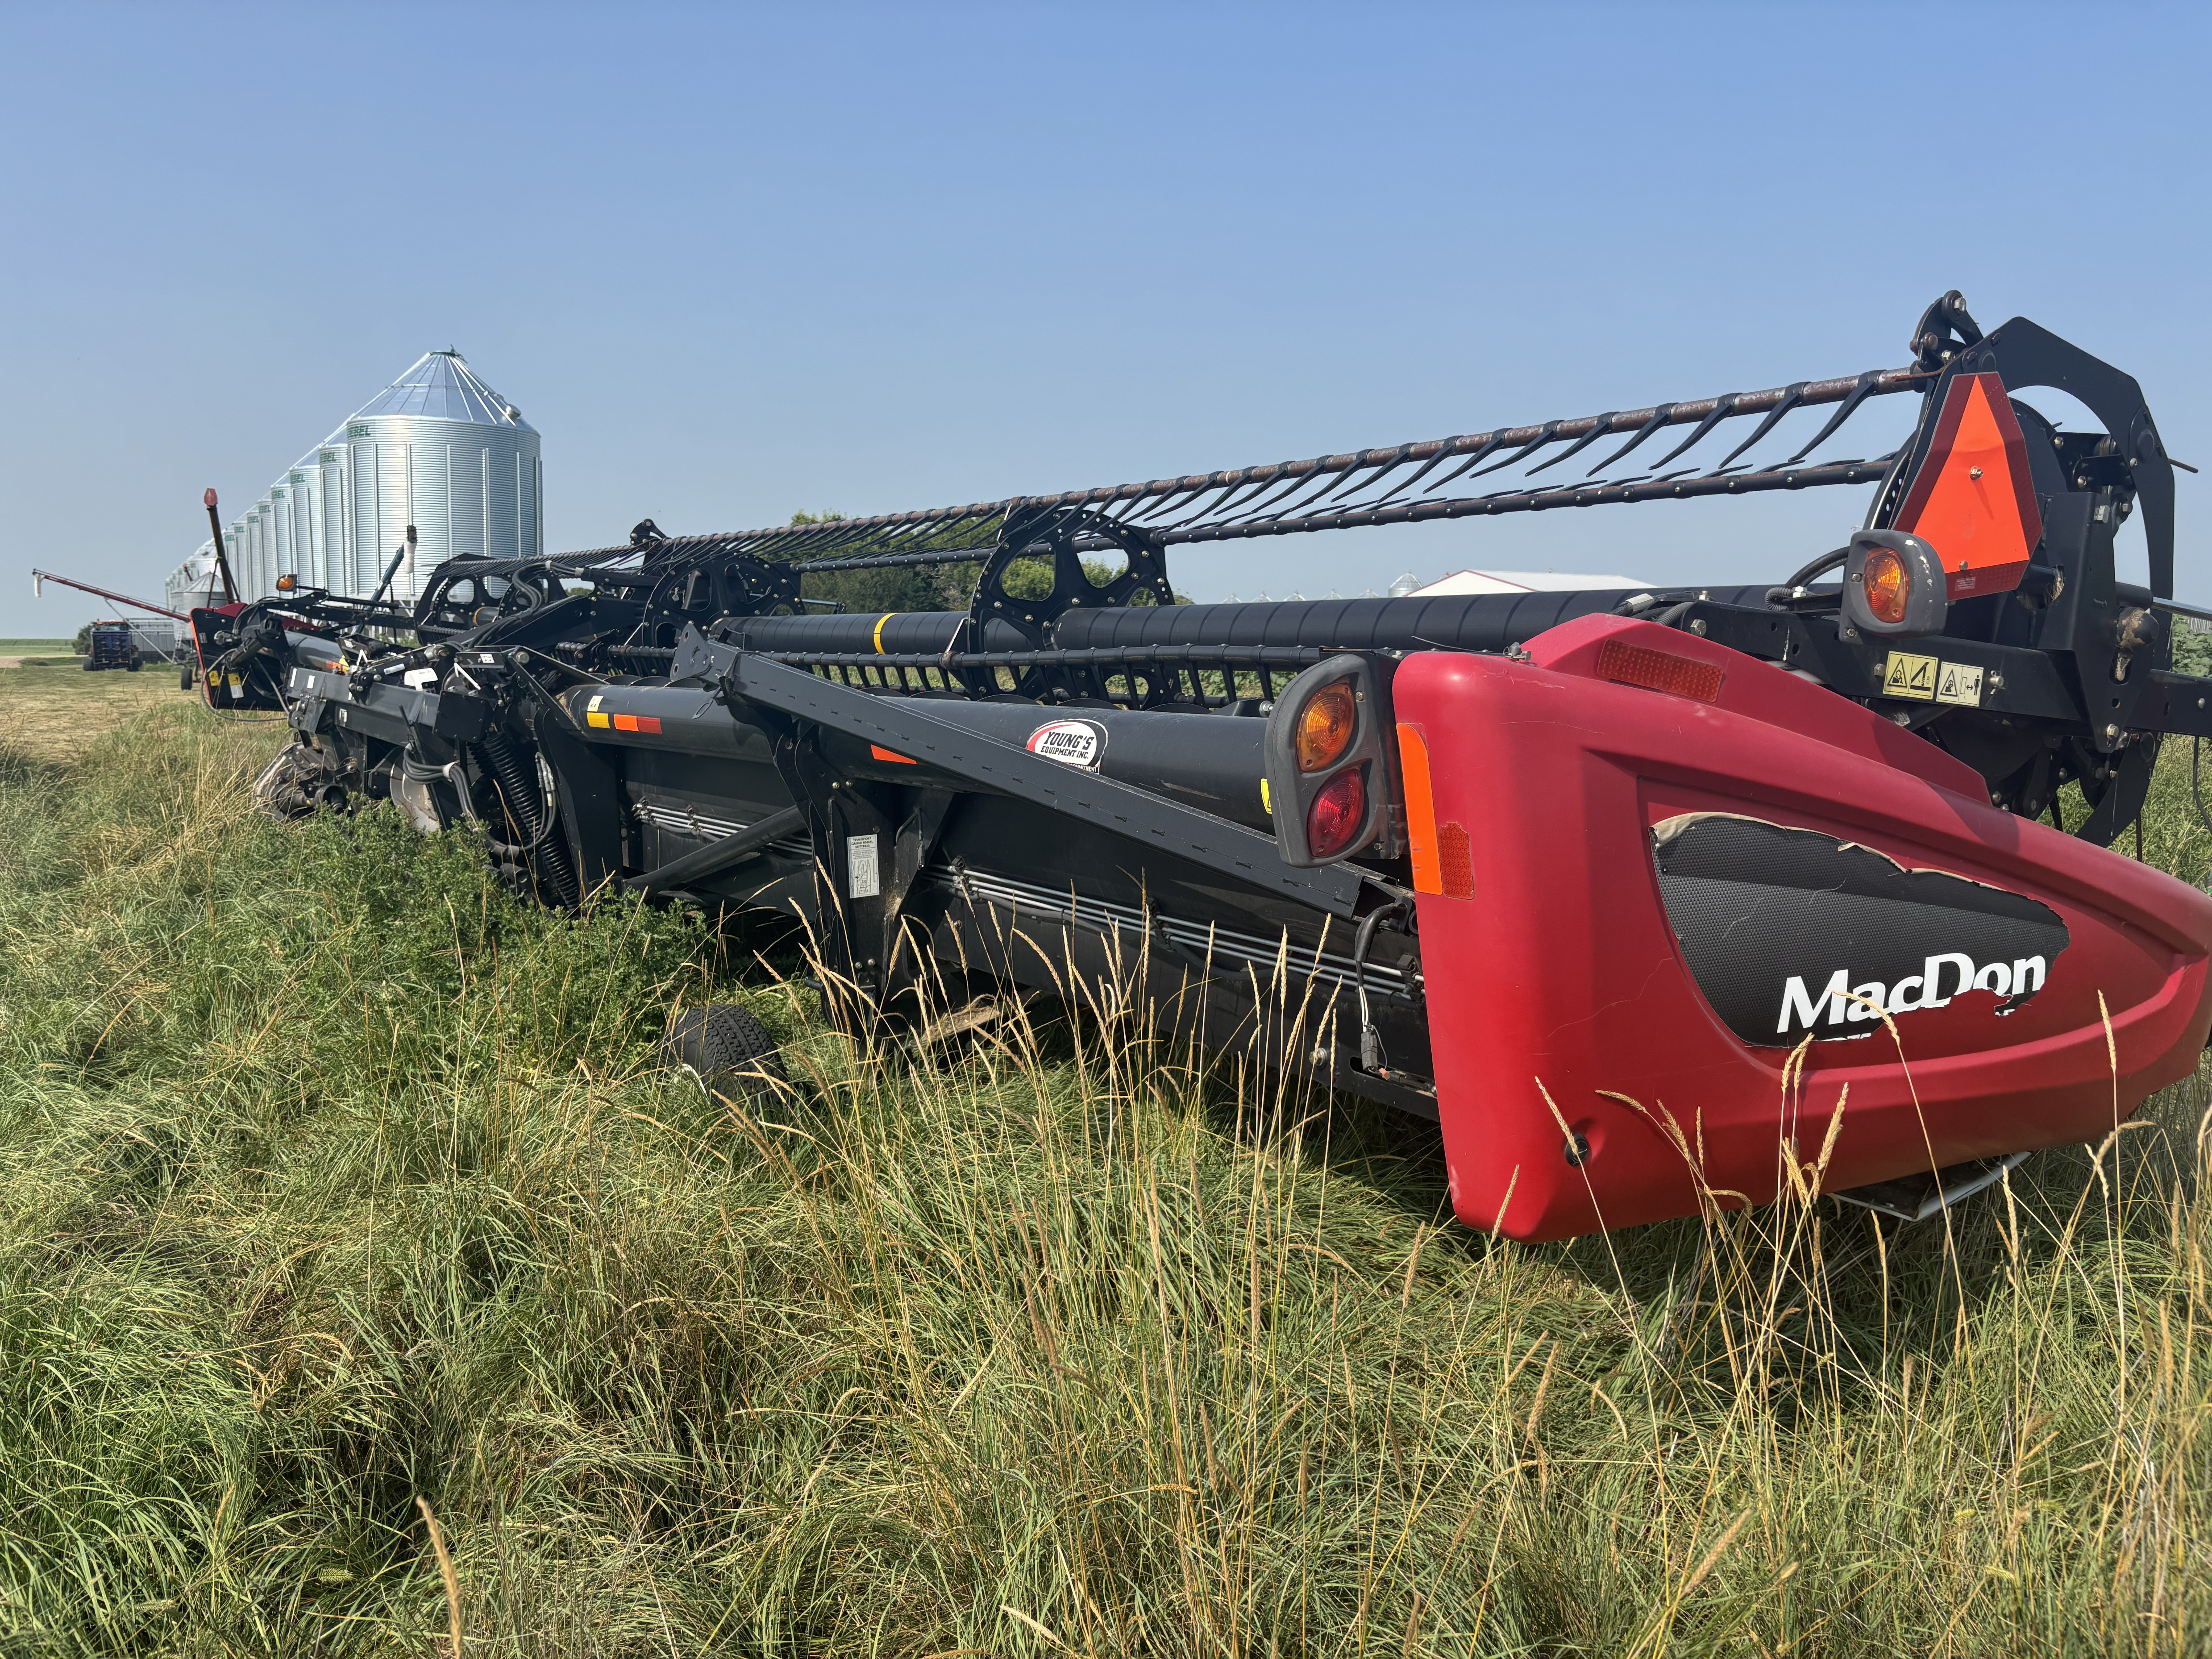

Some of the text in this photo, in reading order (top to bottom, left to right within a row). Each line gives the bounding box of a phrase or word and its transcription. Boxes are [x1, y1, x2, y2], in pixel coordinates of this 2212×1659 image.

[1044, 732, 1094, 750] YOUNG'S
[1041, 745, 1089, 759] EQUIPMENT INC.
[1777, 953, 2046, 1034] MacDon
